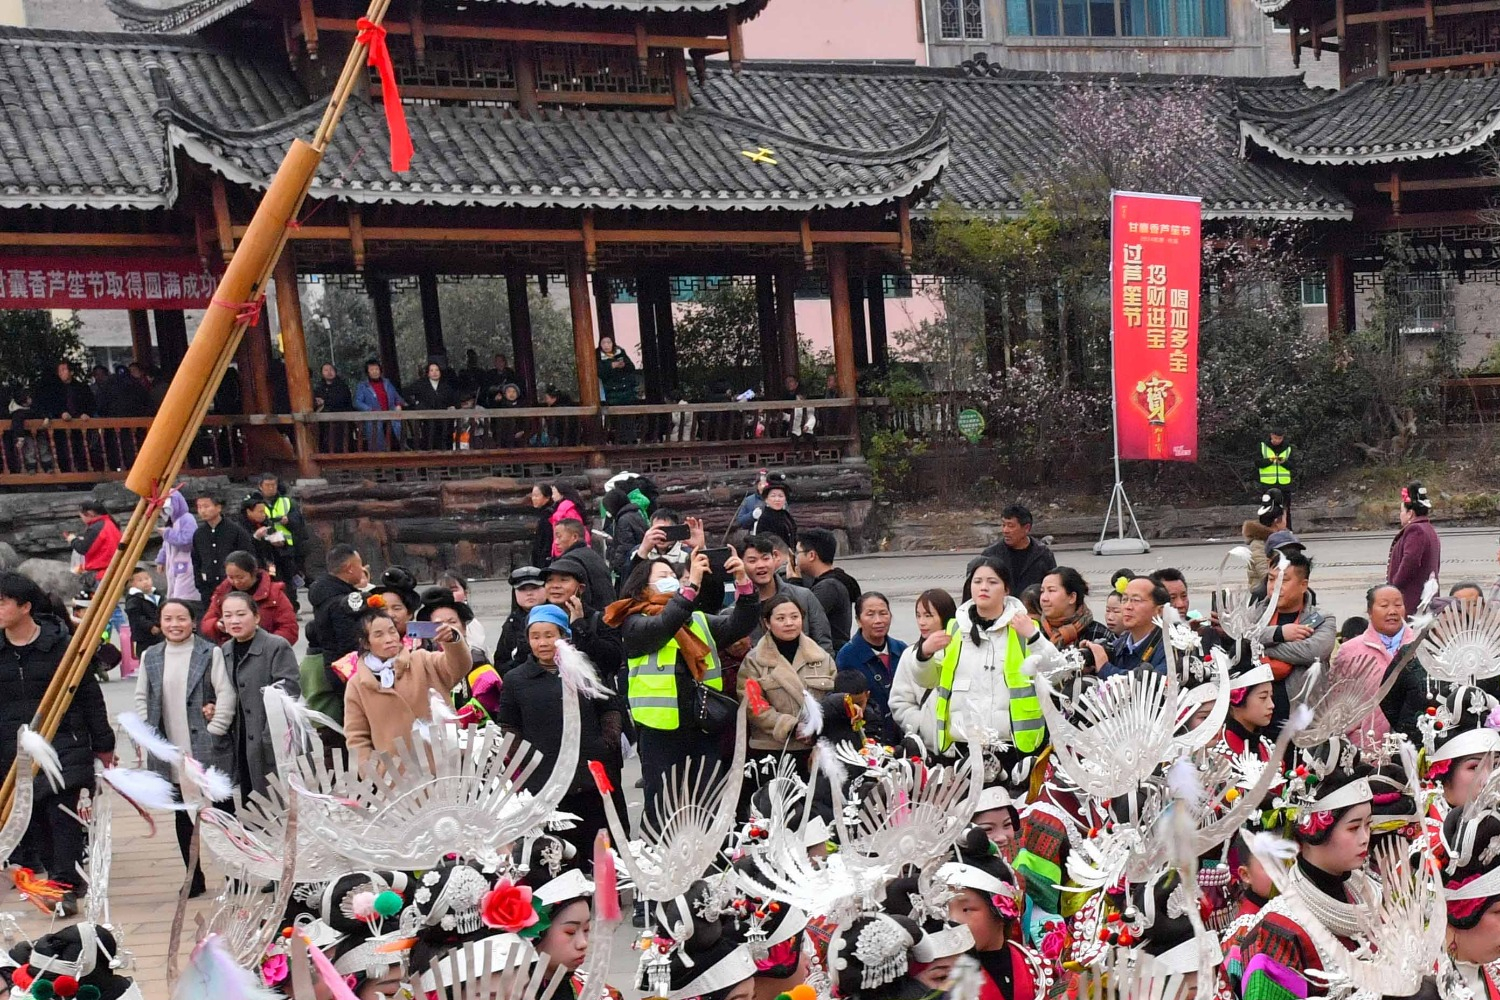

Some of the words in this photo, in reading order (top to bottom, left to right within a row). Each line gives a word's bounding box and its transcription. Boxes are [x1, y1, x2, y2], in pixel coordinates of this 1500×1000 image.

[1123, 243, 1143, 327] 过芦笙节
[1147, 264, 1166, 349] 招财进宝
[1170, 288, 1189, 373] 喝加多宝
